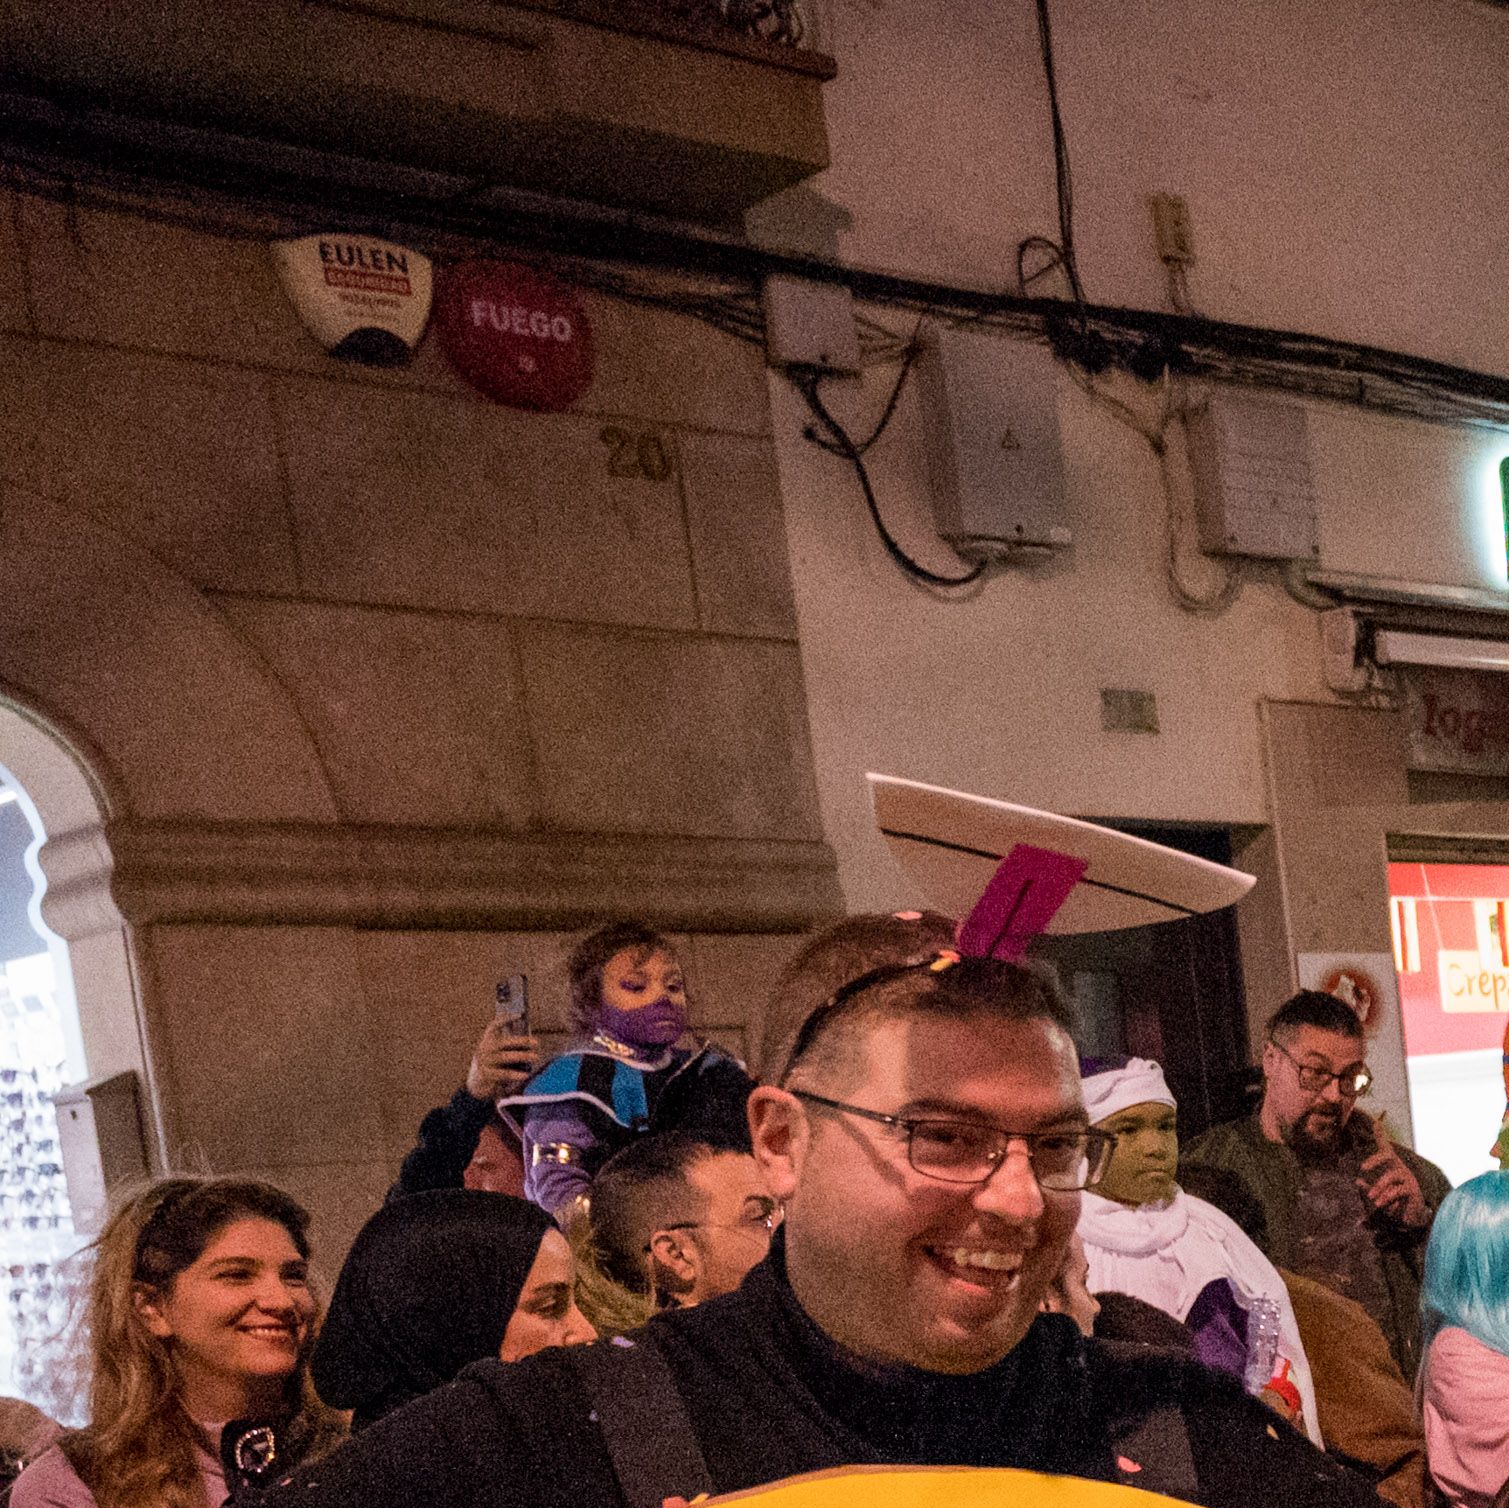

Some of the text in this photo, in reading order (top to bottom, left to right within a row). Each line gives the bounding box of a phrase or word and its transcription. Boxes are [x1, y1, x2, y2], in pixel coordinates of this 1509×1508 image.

[320, 241, 409, 275] EULEN
[471, 299, 572, 342] FUEGO
[600, 427, 673, 481] 20
